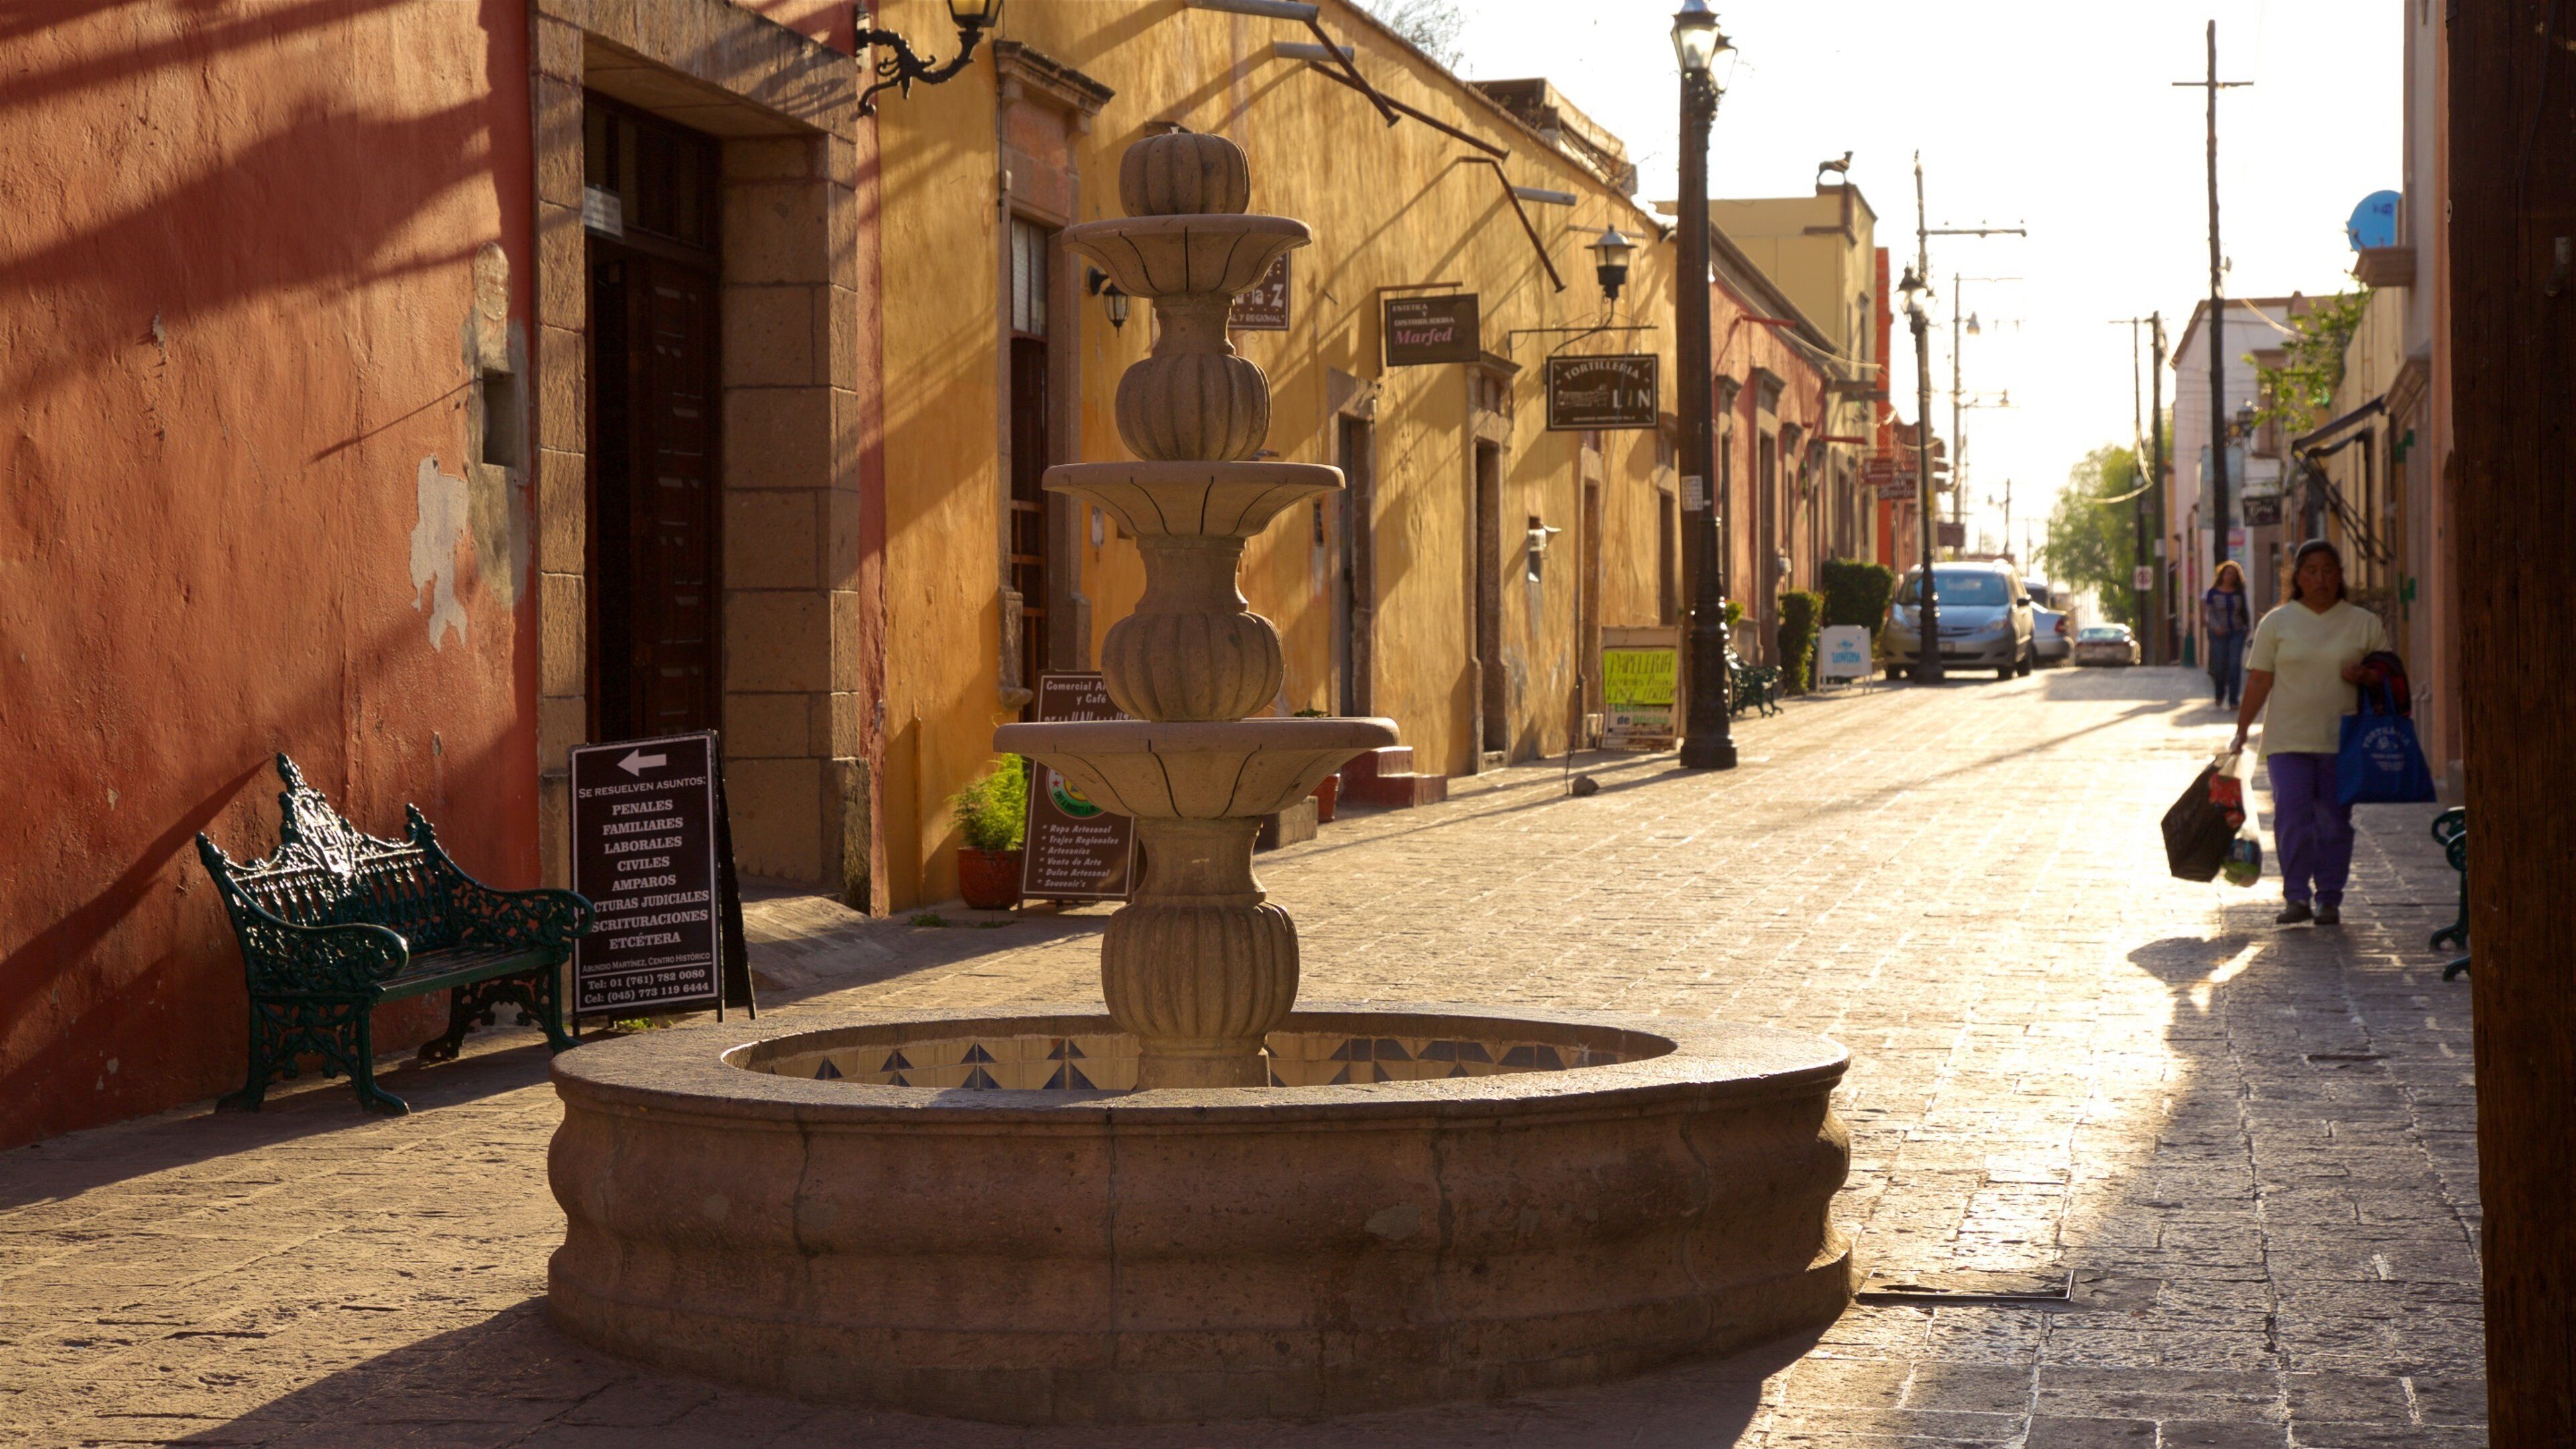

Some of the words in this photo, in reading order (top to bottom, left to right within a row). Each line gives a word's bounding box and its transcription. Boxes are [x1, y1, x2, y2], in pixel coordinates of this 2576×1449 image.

[1271, 283, 1284, 308] Z
[1246, 313, 1281, 322] REGIONAL
[1395, 327, 1454, 347] Marfed
[1046, 680, 1091, 691] Comercial
[1077, 696, 1082, 706] y
[1085, 694, 1106, 704] Café
[1617, 716, 1629, 724] de
[594, 782, 654, 797] RESUELVEN
[656, 776, 706, 790] ASUNTOS:
[612, 800, 673, 816] PENALES
[602, 817, 684, 835] FAMILIARES
[1050, 824, 1069, 835] Ropa
[1072, 825, 1112, 833] Artesanal
[604, 836, 682, 854] LABORALES
[1049, 836, 1073, 845] Trajes
[1075, 836, 1119, 845] Regionales
[617, 857, 669, 871] CIVILES
[1047, 857, 1069, 865] Venta
[1046, 868, 1068, 876] Dulce
[1070, 869, 1110, 877] Artesanal
[612, 875, 676, 891] AMPAROS
[1044, 879, 1085, 888] Souvenir's
[642, 890, 710, 908] JUDICIALES
[590, 910, 708, 932] SCRITURACIONES
[609, 932, 682, 950] ETCÉTERA
[582, 963, 611, 973] ABUNDIO
[648, 955, 674, 966] CENTRO
[588, 979, 606, 990] Tel:
[610, 979, 622, 987] 01
[626, 975, 654, 987] (761)
[657, 973, 676, 982] 782
[679, 969, 704, 980] 0080
[584, 994, 604, 1004] Cel:
[608, 989, 635, 1002] (045)
[639, 987, 657, 998] 773
[661, 985, 680, 996] 119
[683, 982, 709, 992] 6444
